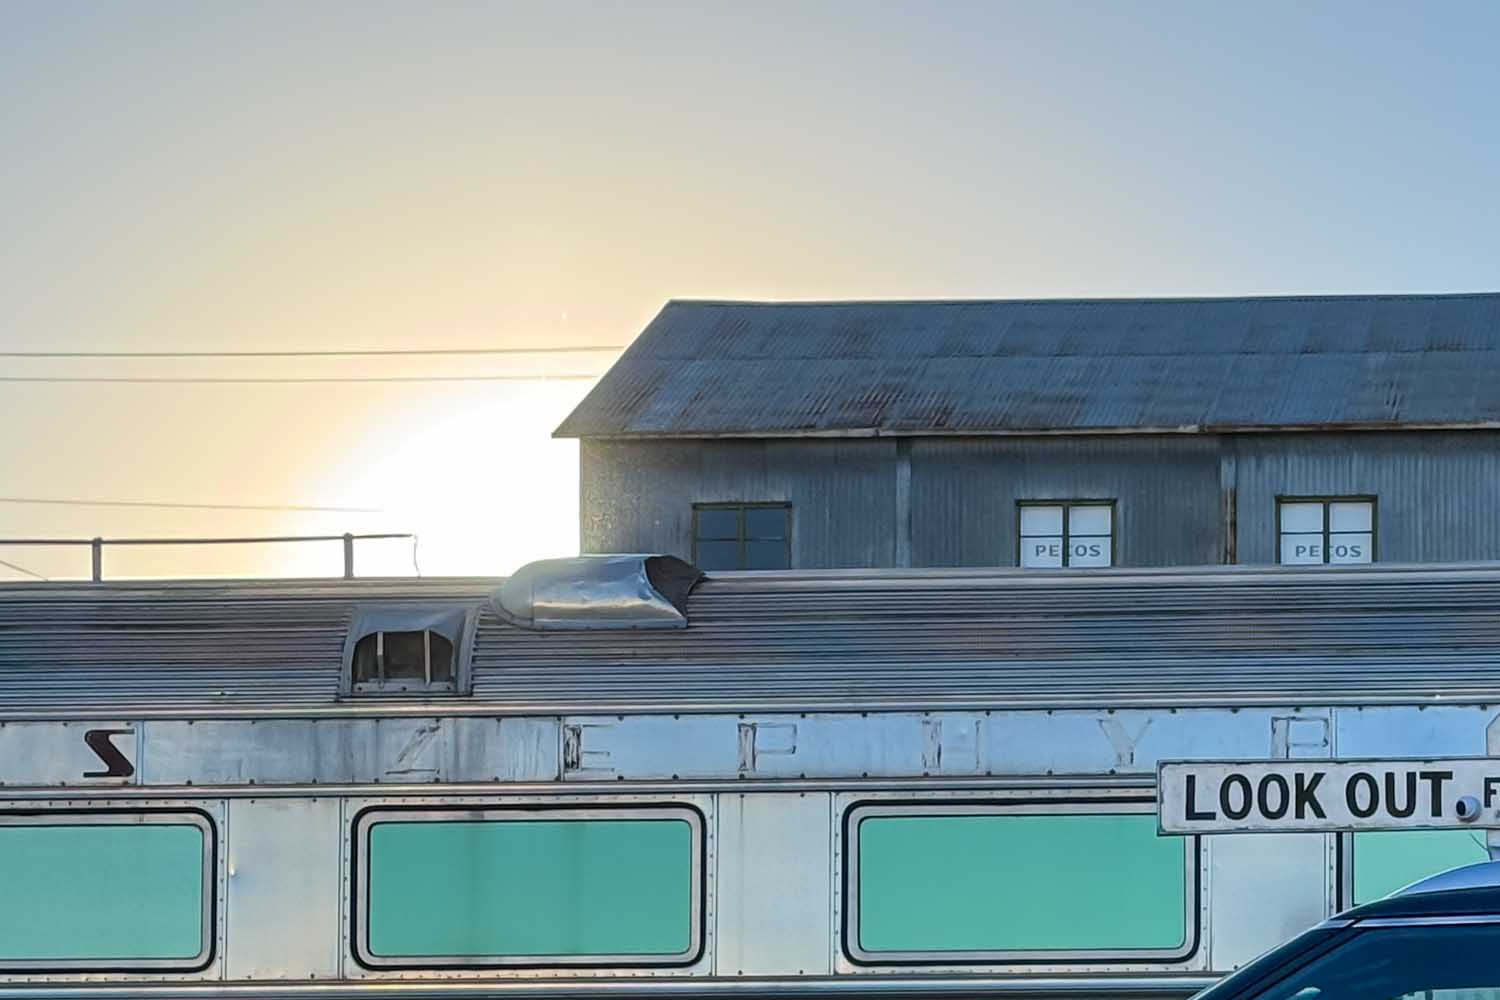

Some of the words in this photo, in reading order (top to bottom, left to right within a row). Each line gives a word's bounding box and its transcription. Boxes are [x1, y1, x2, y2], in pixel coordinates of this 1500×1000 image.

[1035, 544, 1101, 557] PEOS
[1295, 544, 1361, 558] PEOS
[1185, 773, 1327, 821] LOOK
[1345, 770, 1454, 819] OUT
